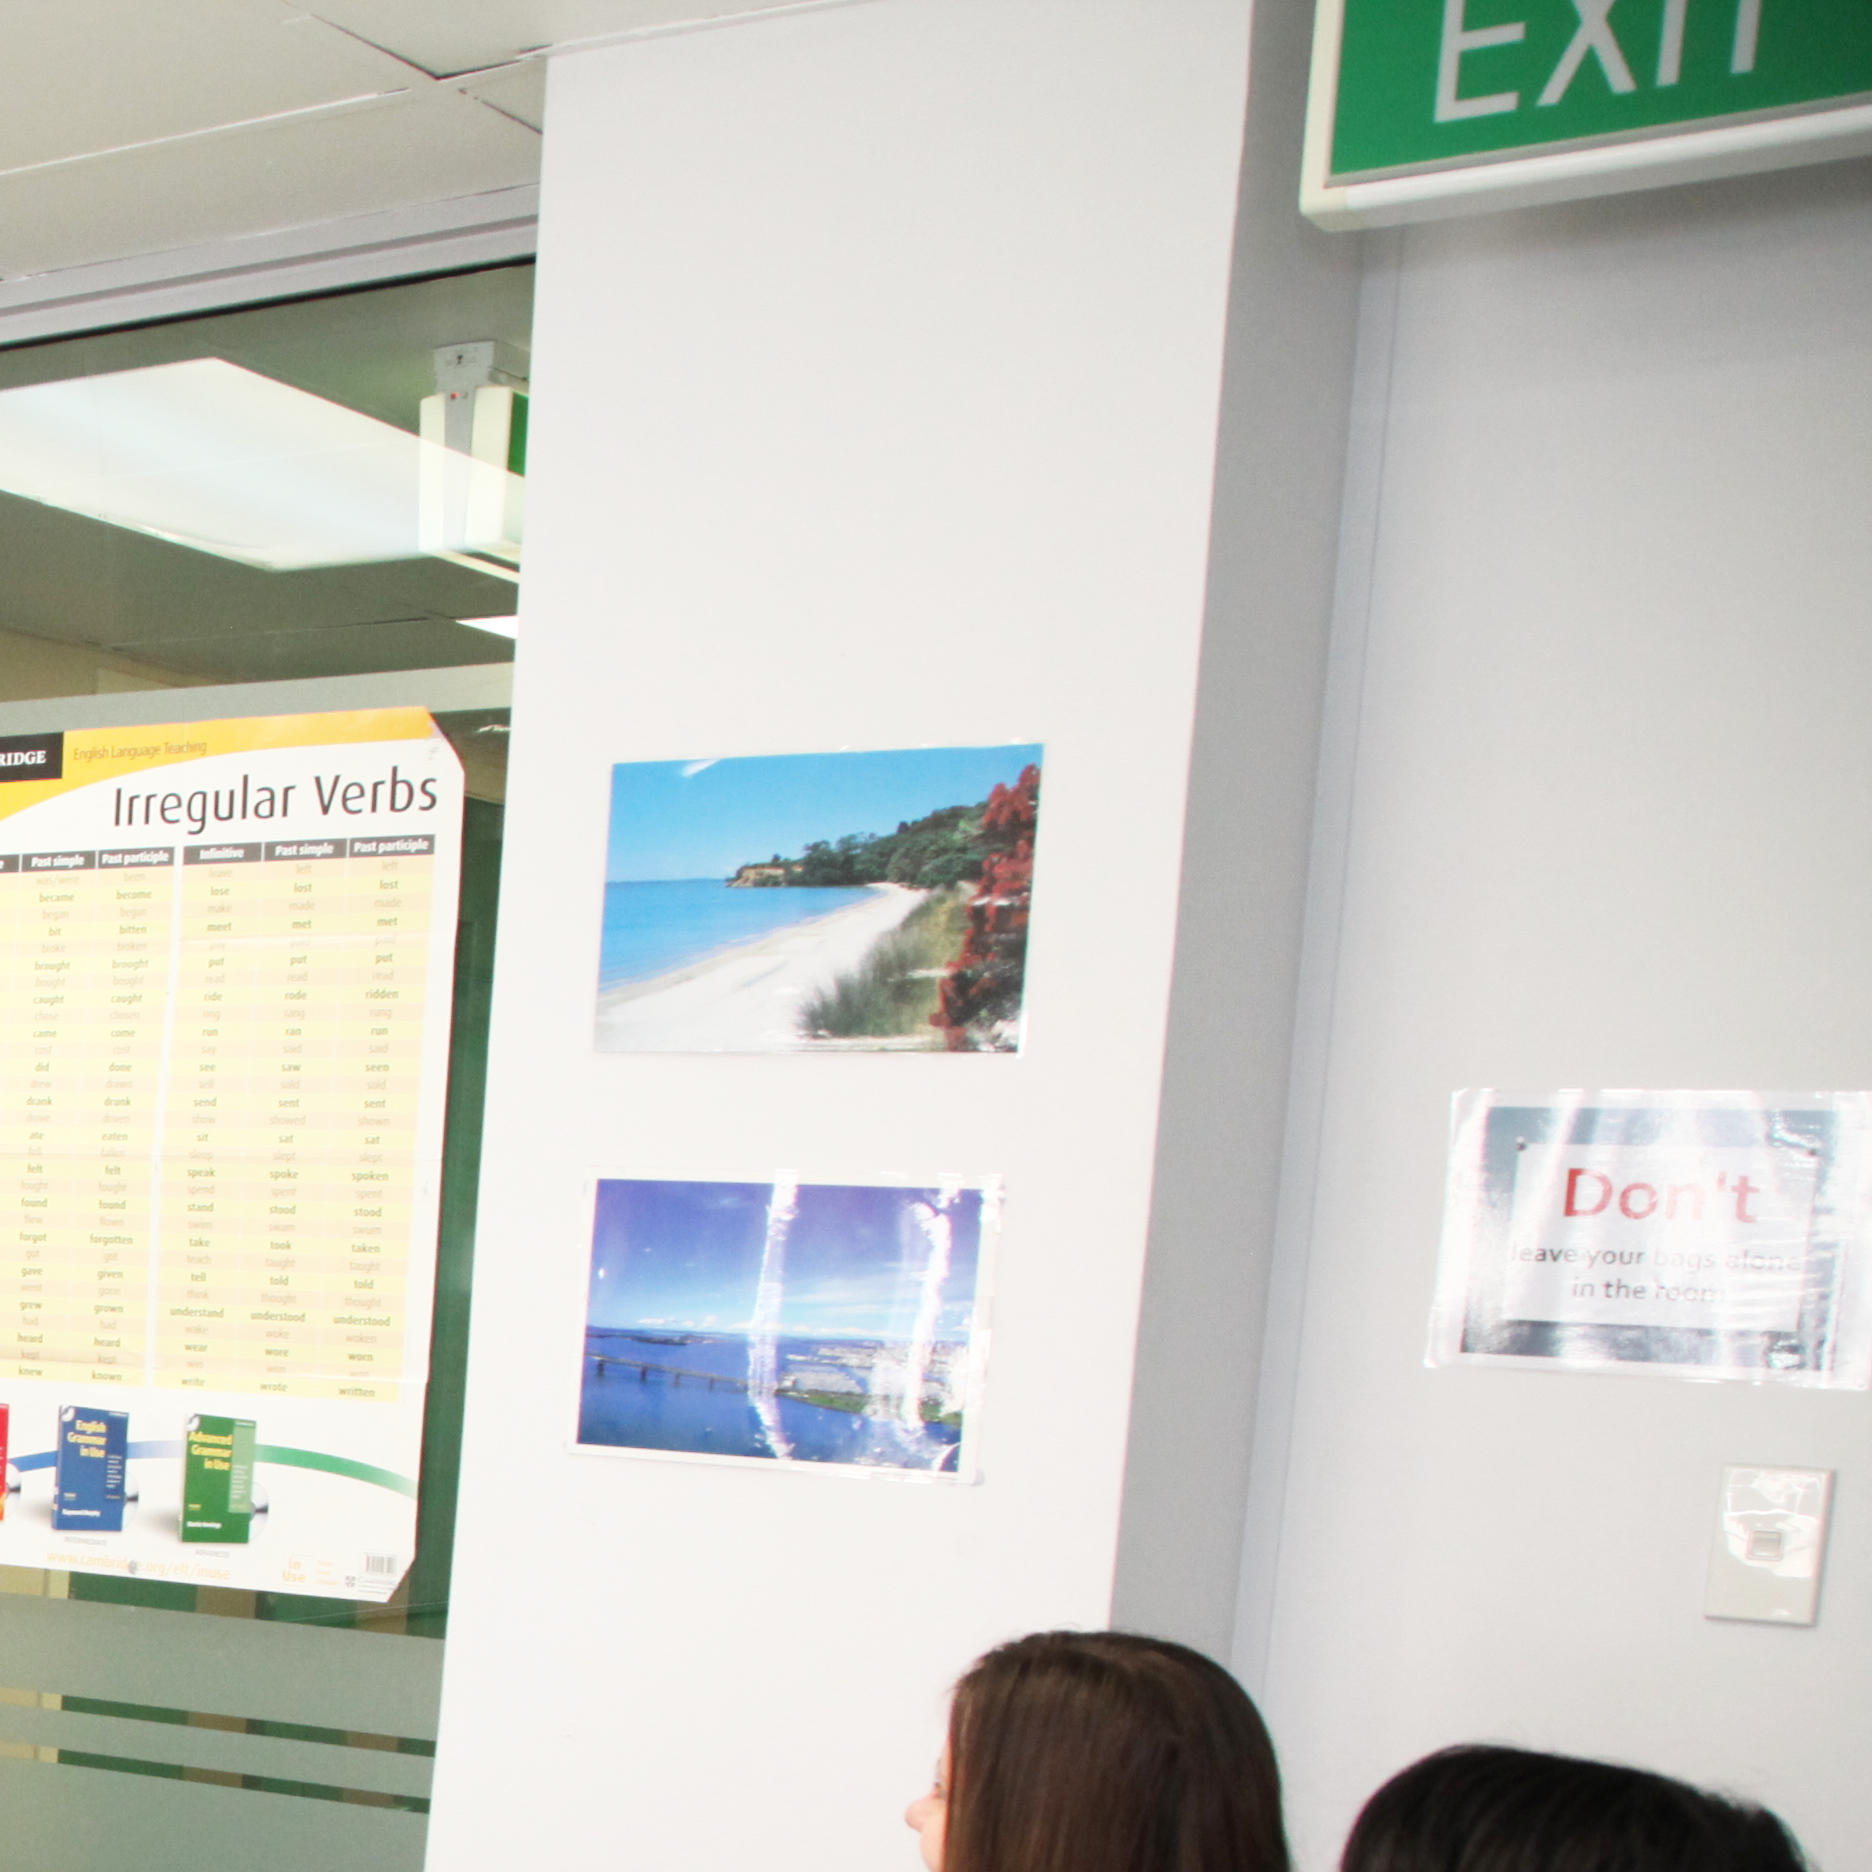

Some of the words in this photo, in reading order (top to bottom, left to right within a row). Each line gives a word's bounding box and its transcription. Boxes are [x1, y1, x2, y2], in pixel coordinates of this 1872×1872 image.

[73, 745, 110, 763] English
[111, 742, 162, 760] Language
[164, 740, 208, 757] Teaching
[114, 774, 297, 836] Irregular
[313, 765, 439, 816] Verbs
[30, 855, 52, 868] Past
[53, 854, 86, 869] simple
[101, 852, 123, 865] Past
[123, 849, 170, 867] participle
[199, 846, 245, 860] Infinitive
[274, 843, 298, 857] Past
[299, 841, 335, 857] simple
[353, 839, 377, 853] Past
[377, 837, 430, 855] participle
[294, 883, 312, 893] lost
[379, 880, 398, 890] lost
[1563, 1166, 1761, 1224] Don't
[1512, 1243, 1579, 1264] leave
[1587, 1248, 1647, 1269] your
[1571, 1276, 1596, 1298] in
[1603, 1278, 1648, 1300] the
